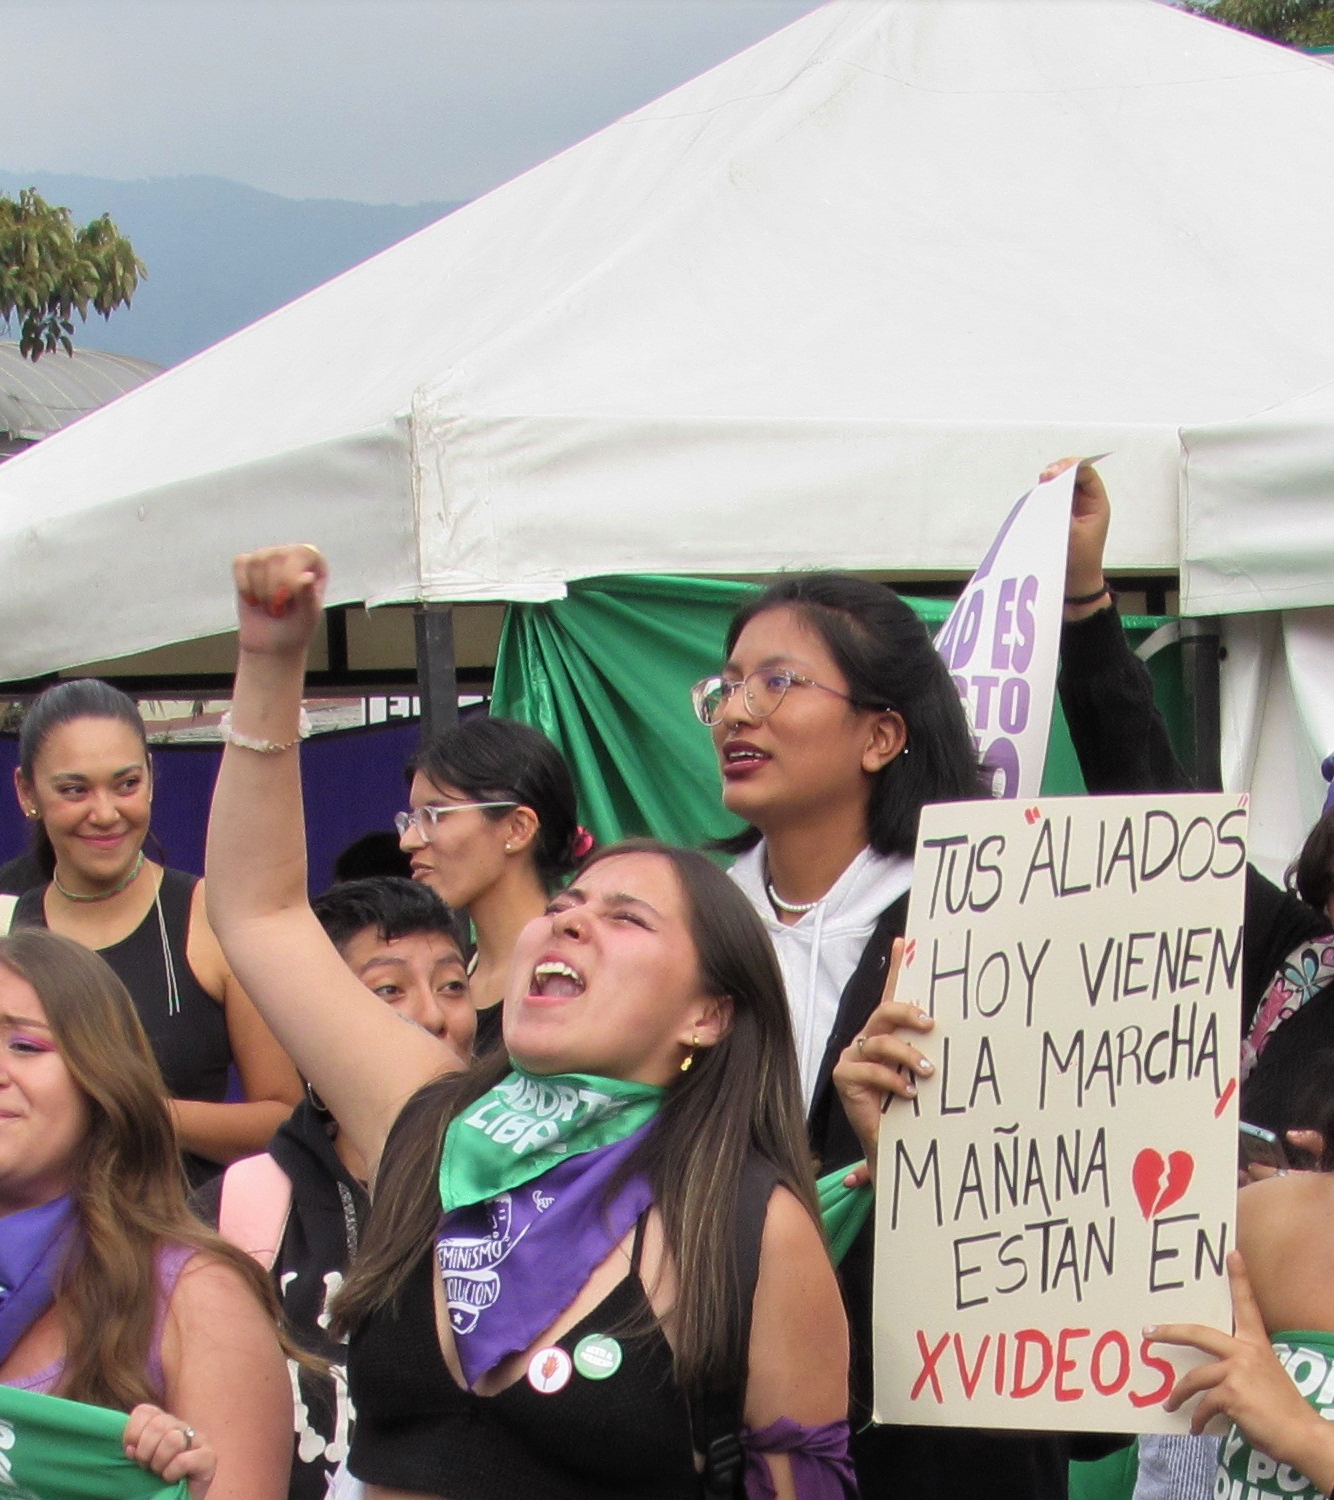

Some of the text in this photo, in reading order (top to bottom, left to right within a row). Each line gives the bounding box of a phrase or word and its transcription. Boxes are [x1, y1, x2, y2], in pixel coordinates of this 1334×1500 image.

[990, 574, 1039, 674] ES
[952, 676, 1031, 735] TO
[923, 834, 1006, 920] TUS
[1079, 925, 1244, 1008] VIENEN
[940, 1035, 1002, 1116] LA
[891, 1122, 1111, 1231] MAÑANA
[952, 1213, 1228, 1311] ESTAN EN
[910, 1327, 1177, 1409] XVIDEOS
